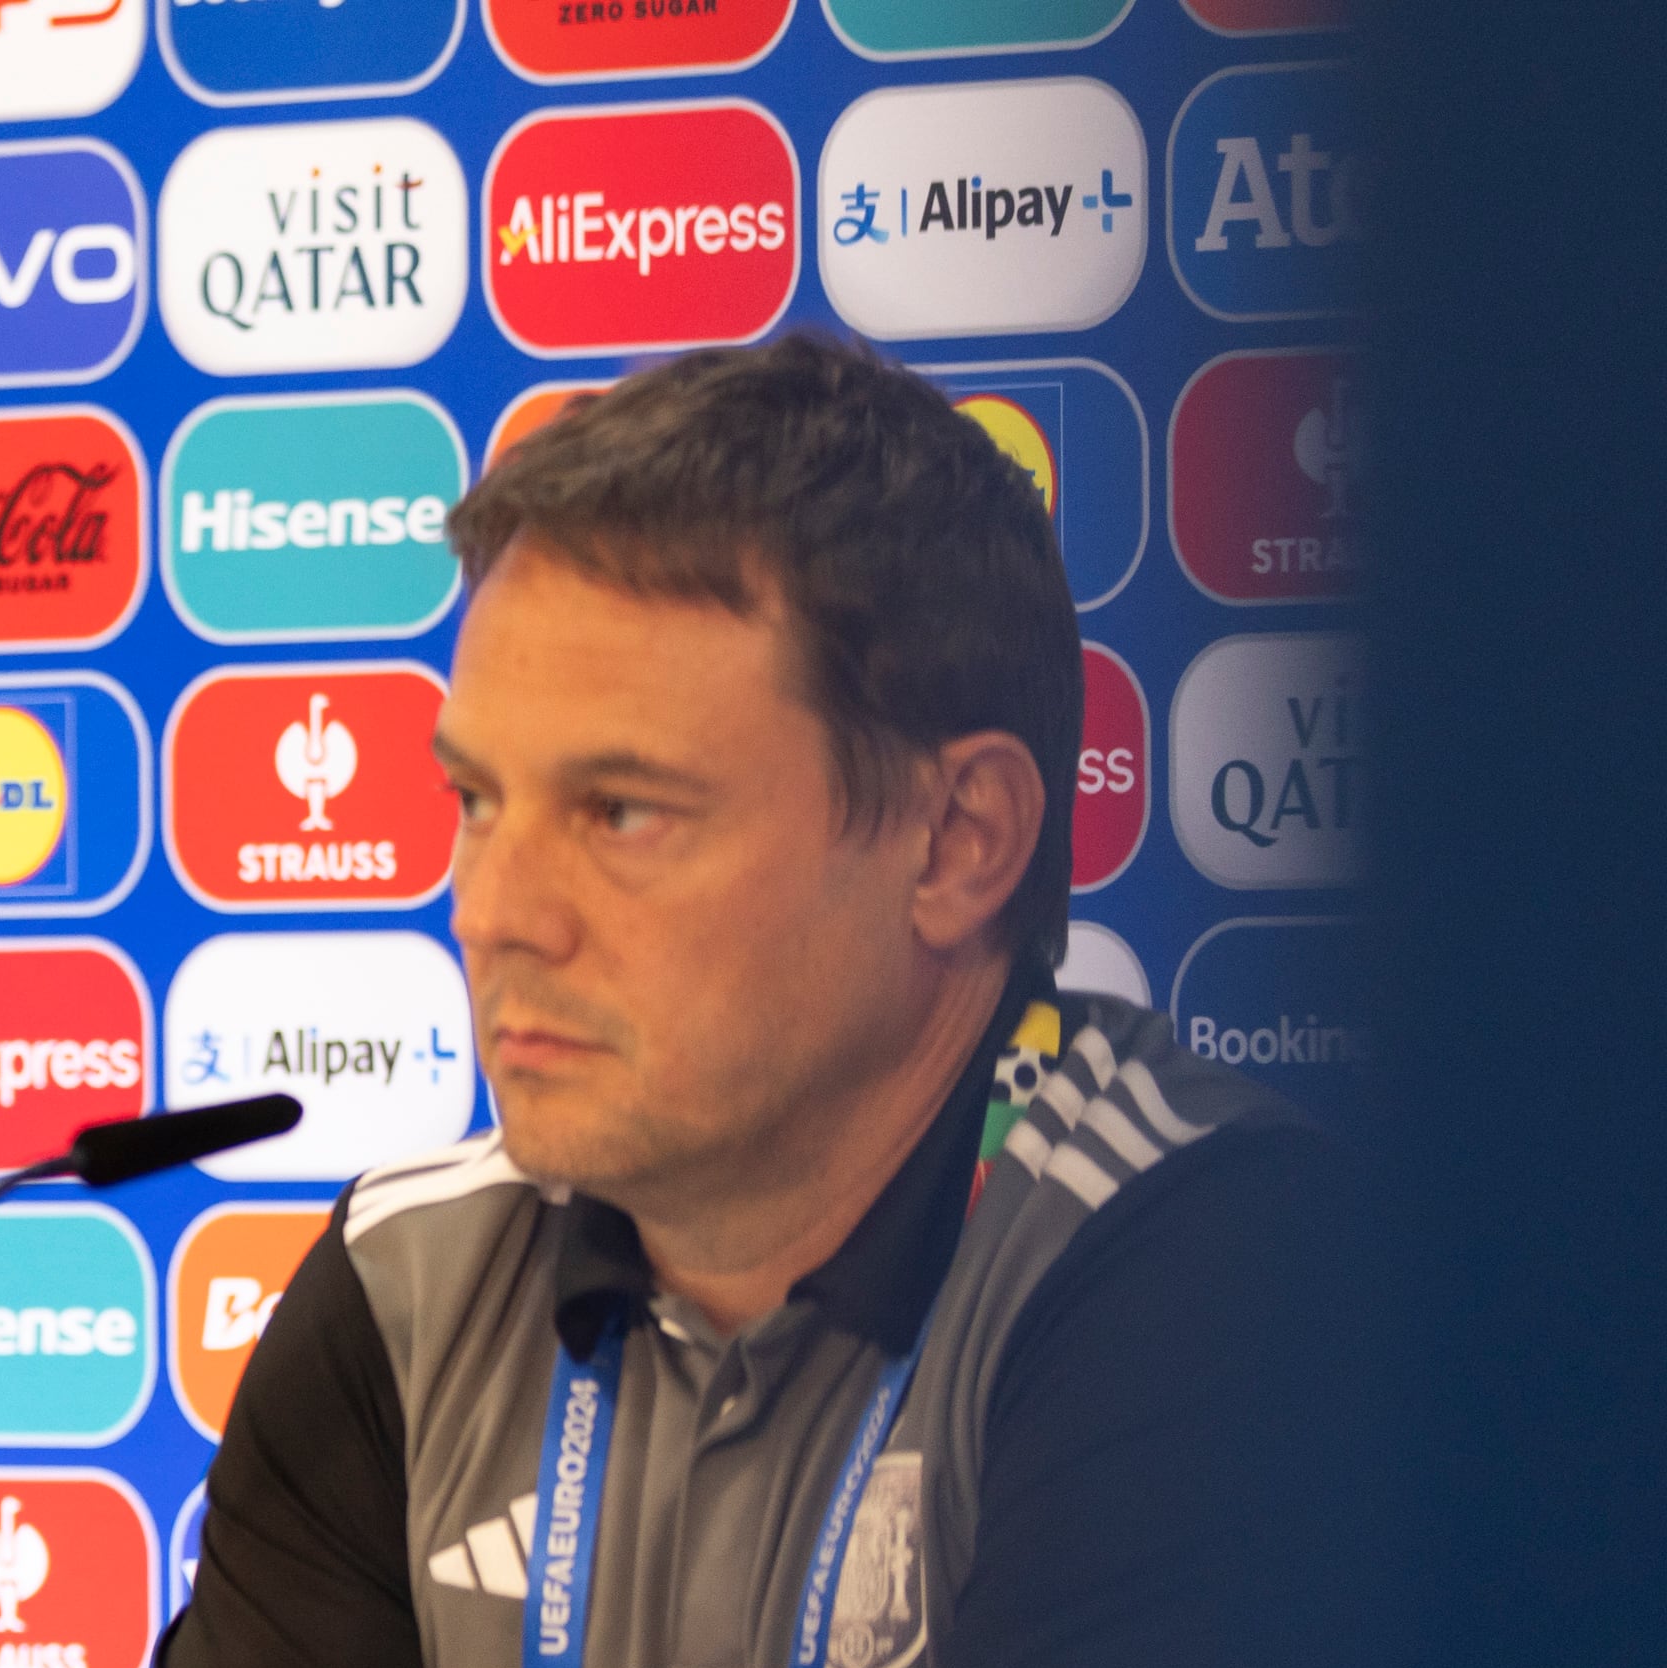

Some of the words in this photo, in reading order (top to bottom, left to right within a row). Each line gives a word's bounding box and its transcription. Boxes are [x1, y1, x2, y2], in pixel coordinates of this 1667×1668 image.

[558, 3, 622, 26] ZERO
[268, 164, 424, 236] visit
[499, 191, 787, 277] AliExpress
[200, 242, 426, 332] QATAR
[179, 490, 450, 552] Hisense
[237, 842, 397, 884] STRAUSS
[537, 1377, 602, 1655] UEFAEURO2024
